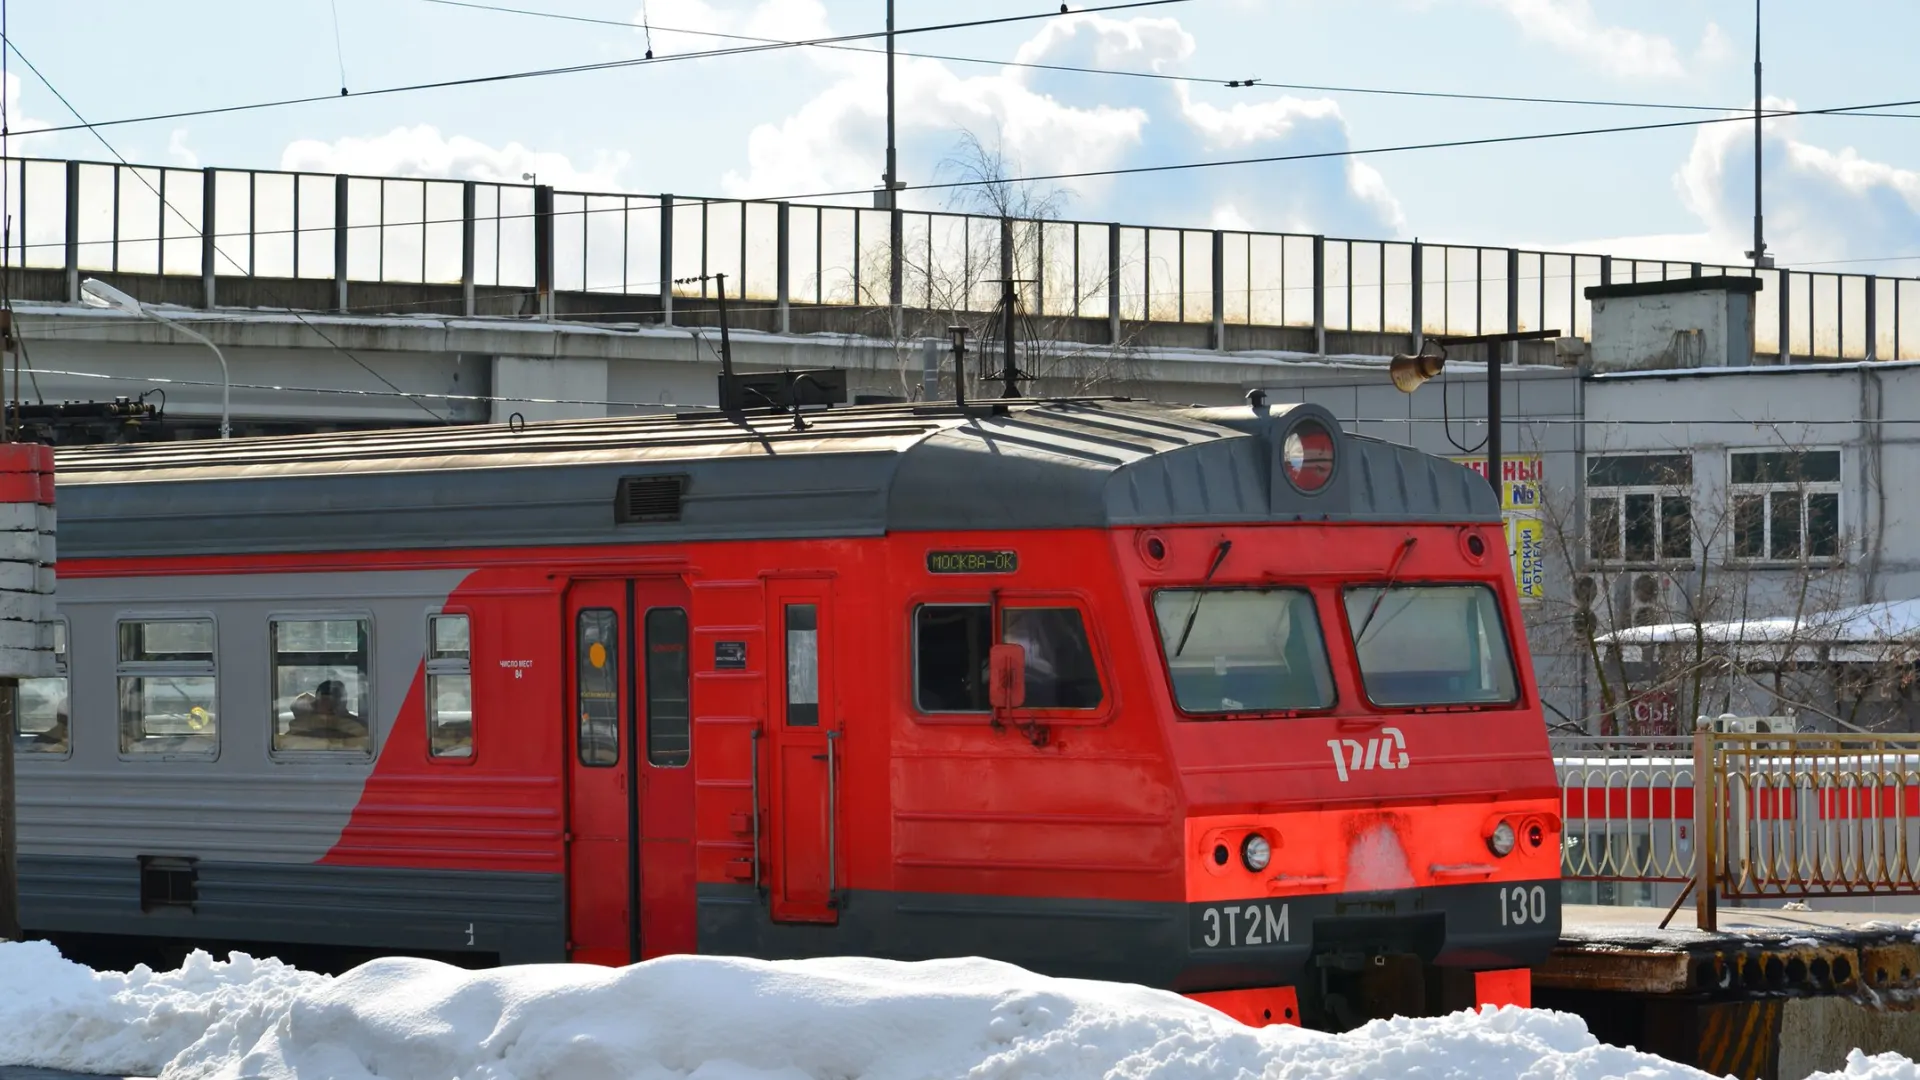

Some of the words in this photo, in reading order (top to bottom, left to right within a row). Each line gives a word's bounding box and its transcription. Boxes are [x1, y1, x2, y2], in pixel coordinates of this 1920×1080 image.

[932, 554, 1013, 569] МОСКВА-ОК
[1520, 529, 1533, 595] ДЕТСКИЙ
[1533, 541, 1543, 585] ОТДЕЛ
[1203, 903, 1290, 948] ЭТ2М
[1500, 885, 1546, 926] 130
